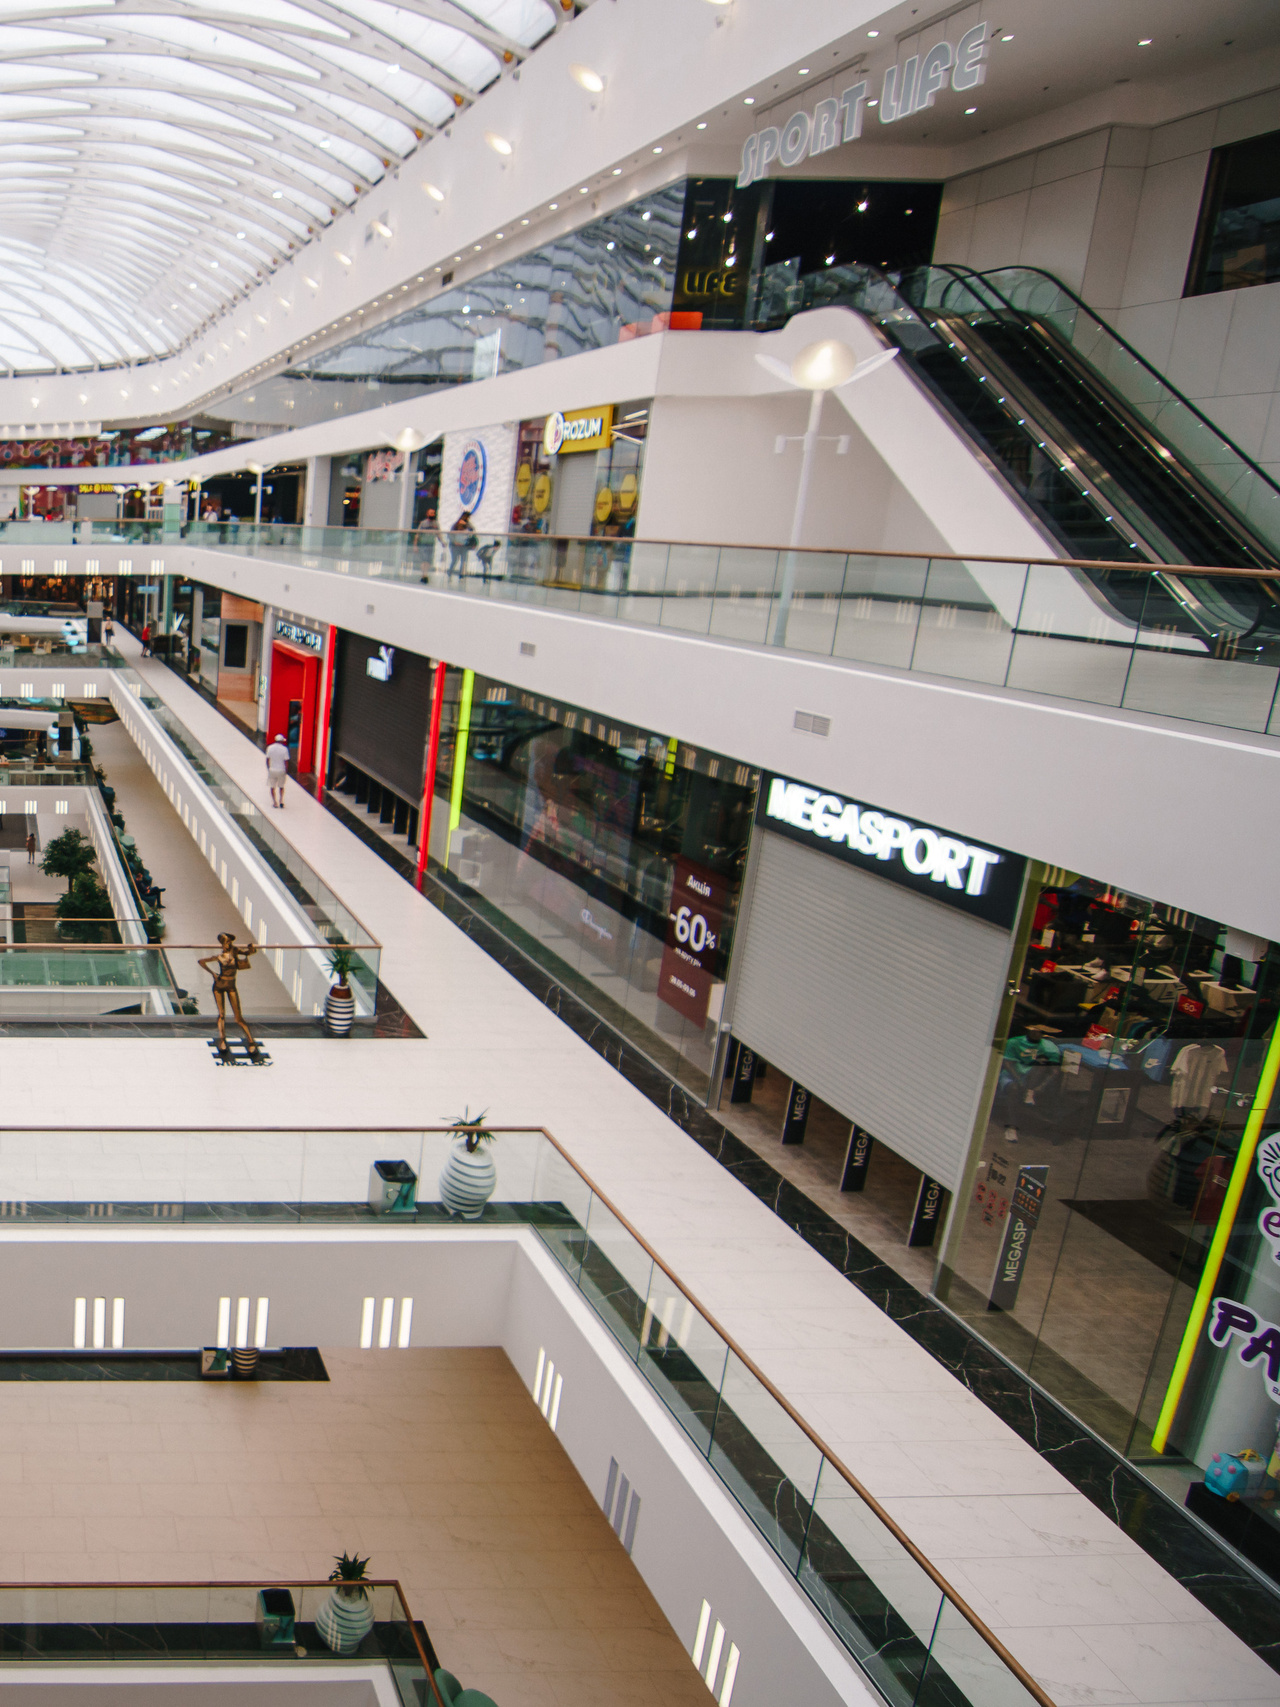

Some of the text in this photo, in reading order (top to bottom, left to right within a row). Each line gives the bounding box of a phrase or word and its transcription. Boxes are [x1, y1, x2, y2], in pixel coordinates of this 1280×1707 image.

[736, 21, 988, 189] SPORT LIFE
[683, 269, 738, 296] LIFE
[766, 778, 1002, 896] MEGASPORT
[686, 874, 712, 897] Акція
[852, 1131, 869, 1167] MEGA
[922, 1182, 940, 1219] MEGA
[1003, 1218, 1027, 1282] MEGASP
